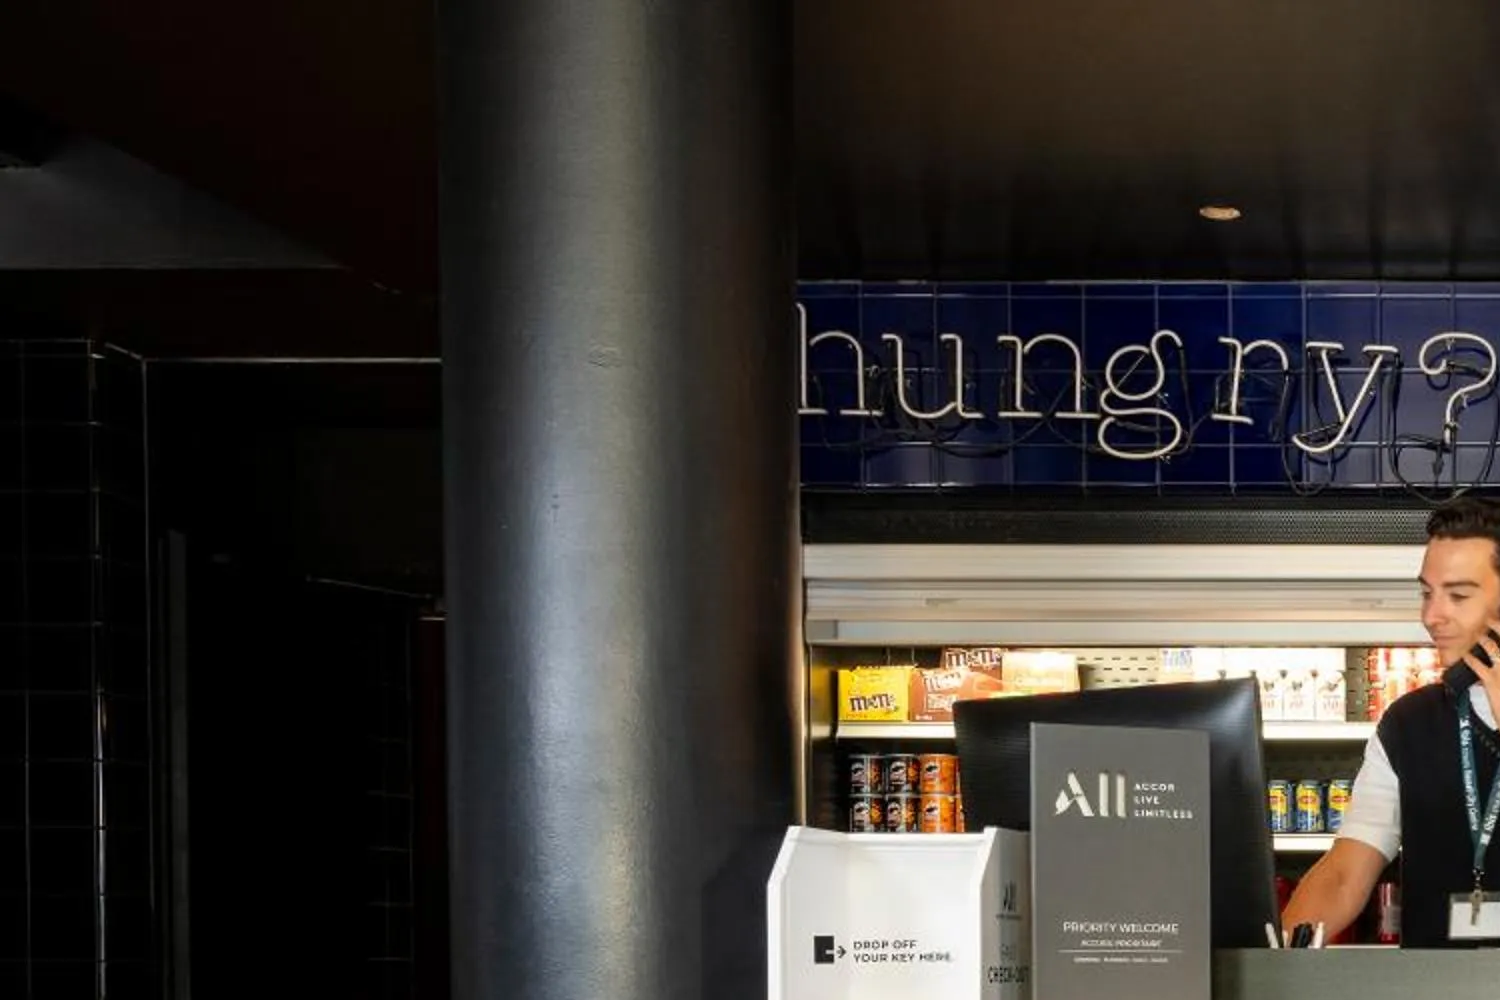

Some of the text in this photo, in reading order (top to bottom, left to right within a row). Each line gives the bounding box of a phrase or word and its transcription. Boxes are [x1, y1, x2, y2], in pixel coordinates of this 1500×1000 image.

[798, 306, 1497, 458] hungry?
[1134, 810, 1193, 819] LIMITLESS
[853, 941, 917, 949] DROP OFF
[853, 953, 888, 962] YOUR
[891, 953, 915, 962] KEY
